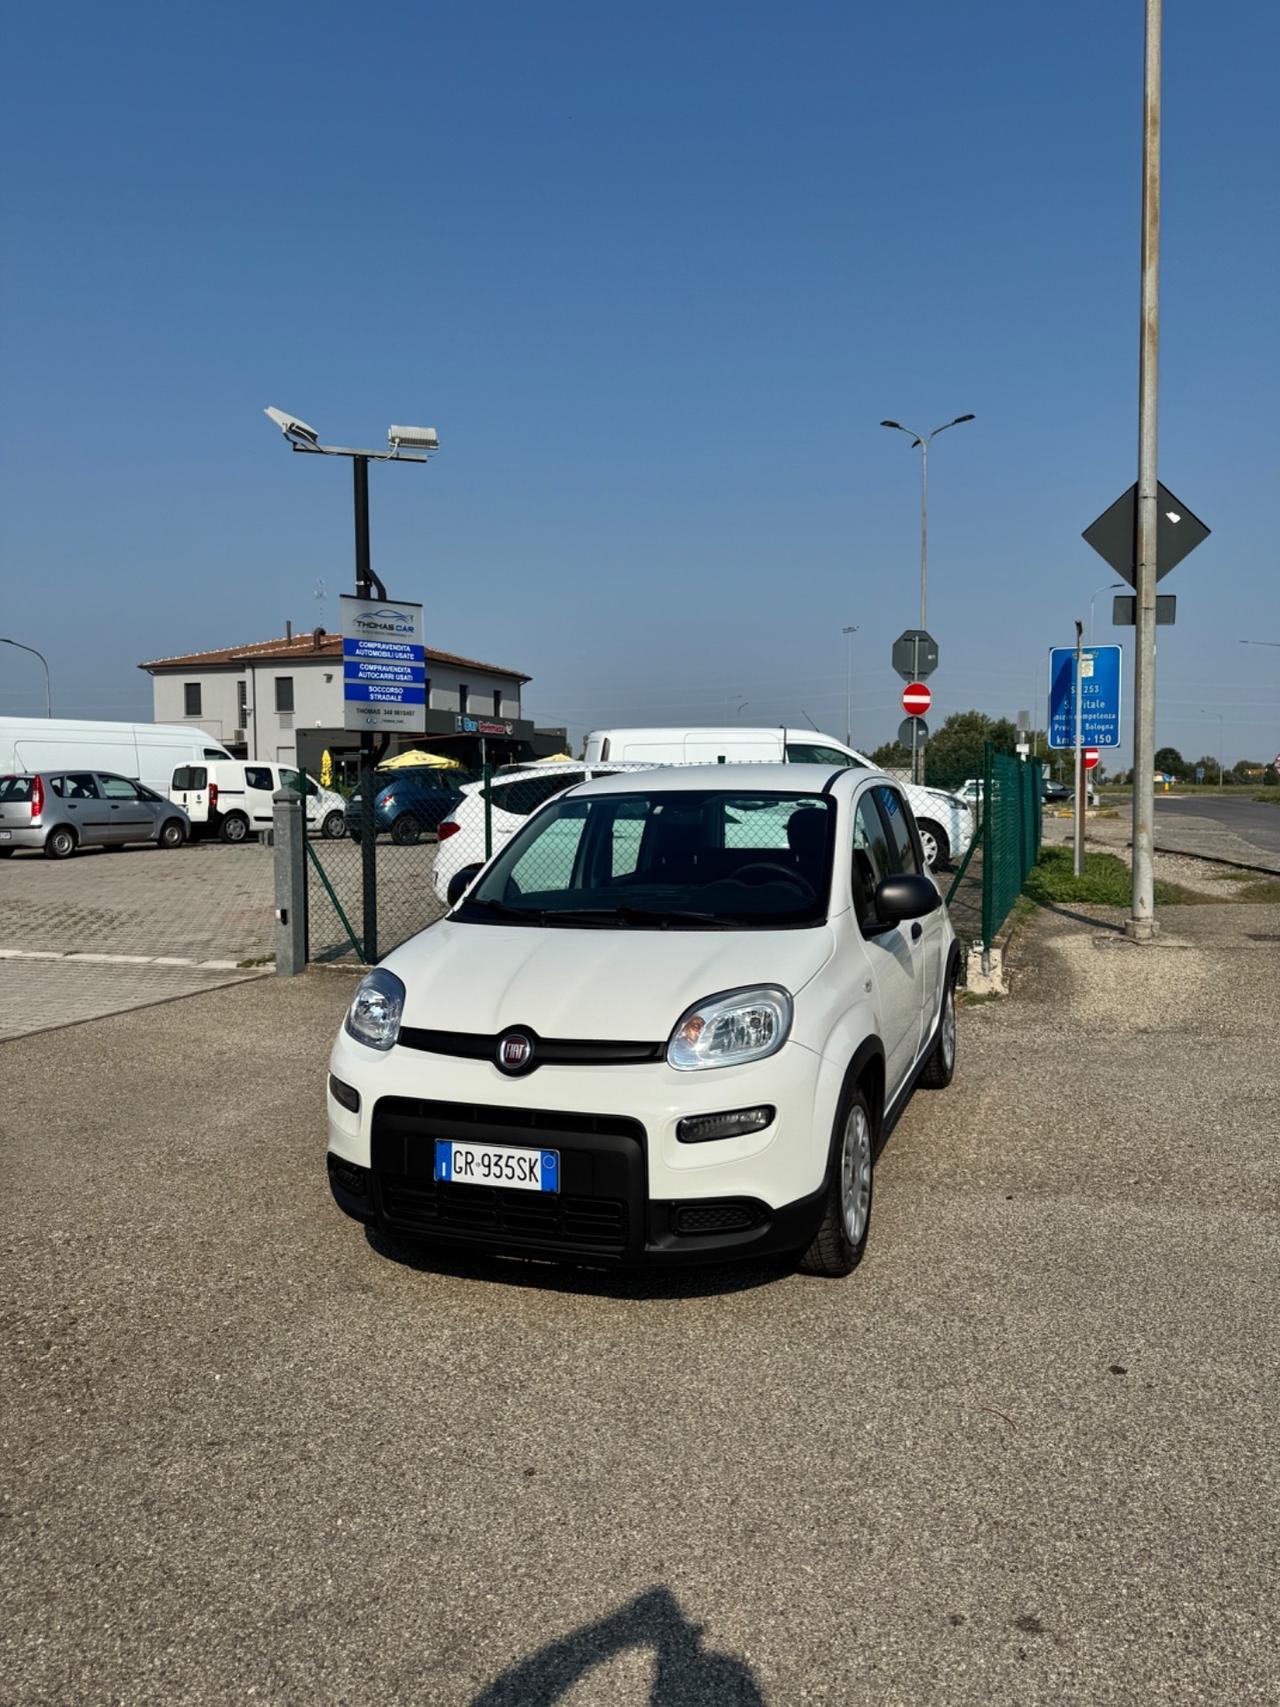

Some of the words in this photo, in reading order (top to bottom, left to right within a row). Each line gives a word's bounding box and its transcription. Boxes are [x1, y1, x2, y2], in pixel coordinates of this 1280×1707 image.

[356, 620, 394, 631] THOMAS
[395, 625, 415, 633] CAR
[358, 641, 411, 652] COMPRAVENDITA
[355, 649, 394, 658] AUTOMOBILI
[395, 652, 415, 660] USATE
[359, 663, 411, 673] COMPRAVENDITA
[358, 671, 394, 680] AUTOCARRI
[368, 685, 404, 694] SOCCORSO
[1083, 684, 1099, 693] 253
[369, 693, 402, 702] STRADALE
[1078, 699, 1106, 709] itale
[356, 707, 381, 715] THOMAS
[1074, 712, 1117, 722] cmpetenza
[1085, 722, 1115, 732] Bologna
[1056, 735, 1070, 745] km
[505, 1043, 525, 1059] FIAT
